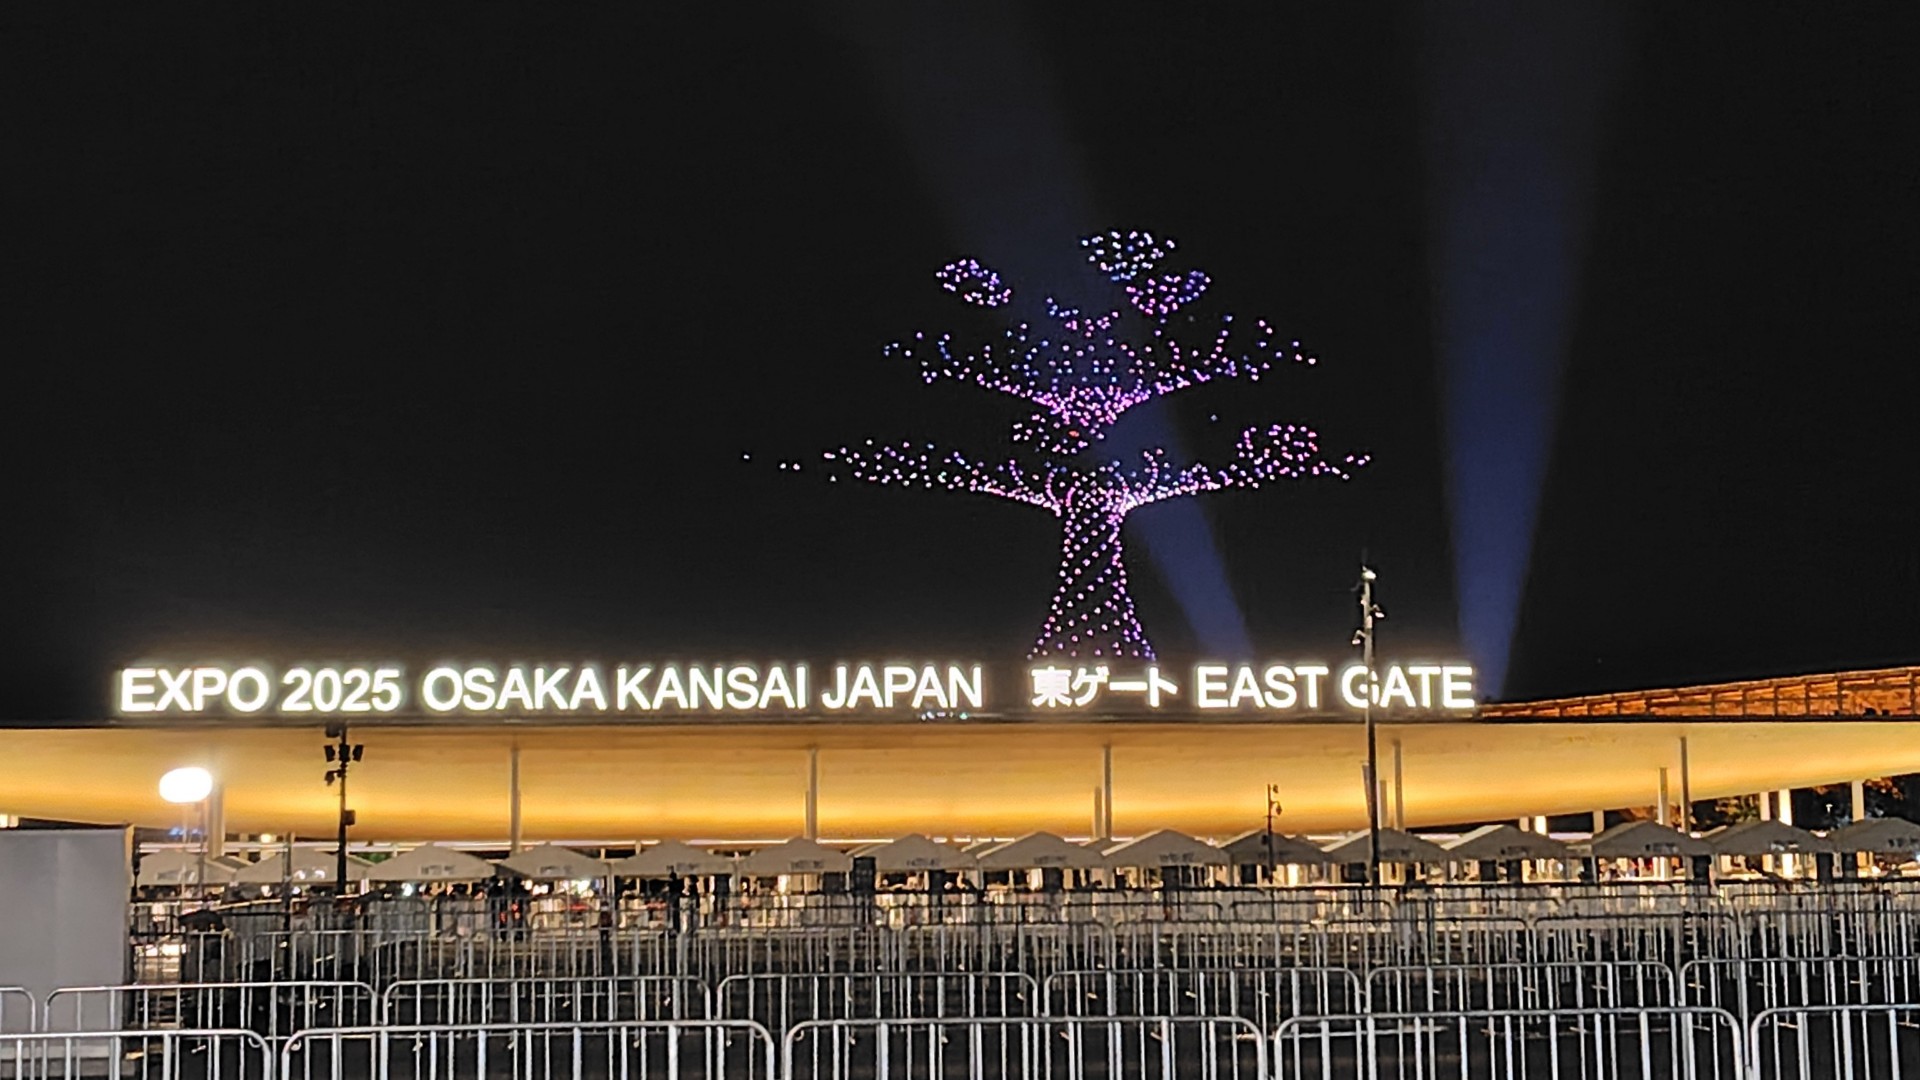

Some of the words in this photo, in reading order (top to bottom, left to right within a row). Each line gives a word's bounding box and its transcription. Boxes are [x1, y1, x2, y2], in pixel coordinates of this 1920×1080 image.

[120, 667, 269, 712] EXPO
[281, 668, 401, 712] 2025
[422, 667, 607, 711] OSAKA
[617, 667, 806, 710] KANSAI
[821, 666, 982, 709] JAPAN
[1031, 665, 1177, 708] 東ゲート
[1197, 666, 1329, 708] EAST
[1341, 665, 1475, 708] GATE
